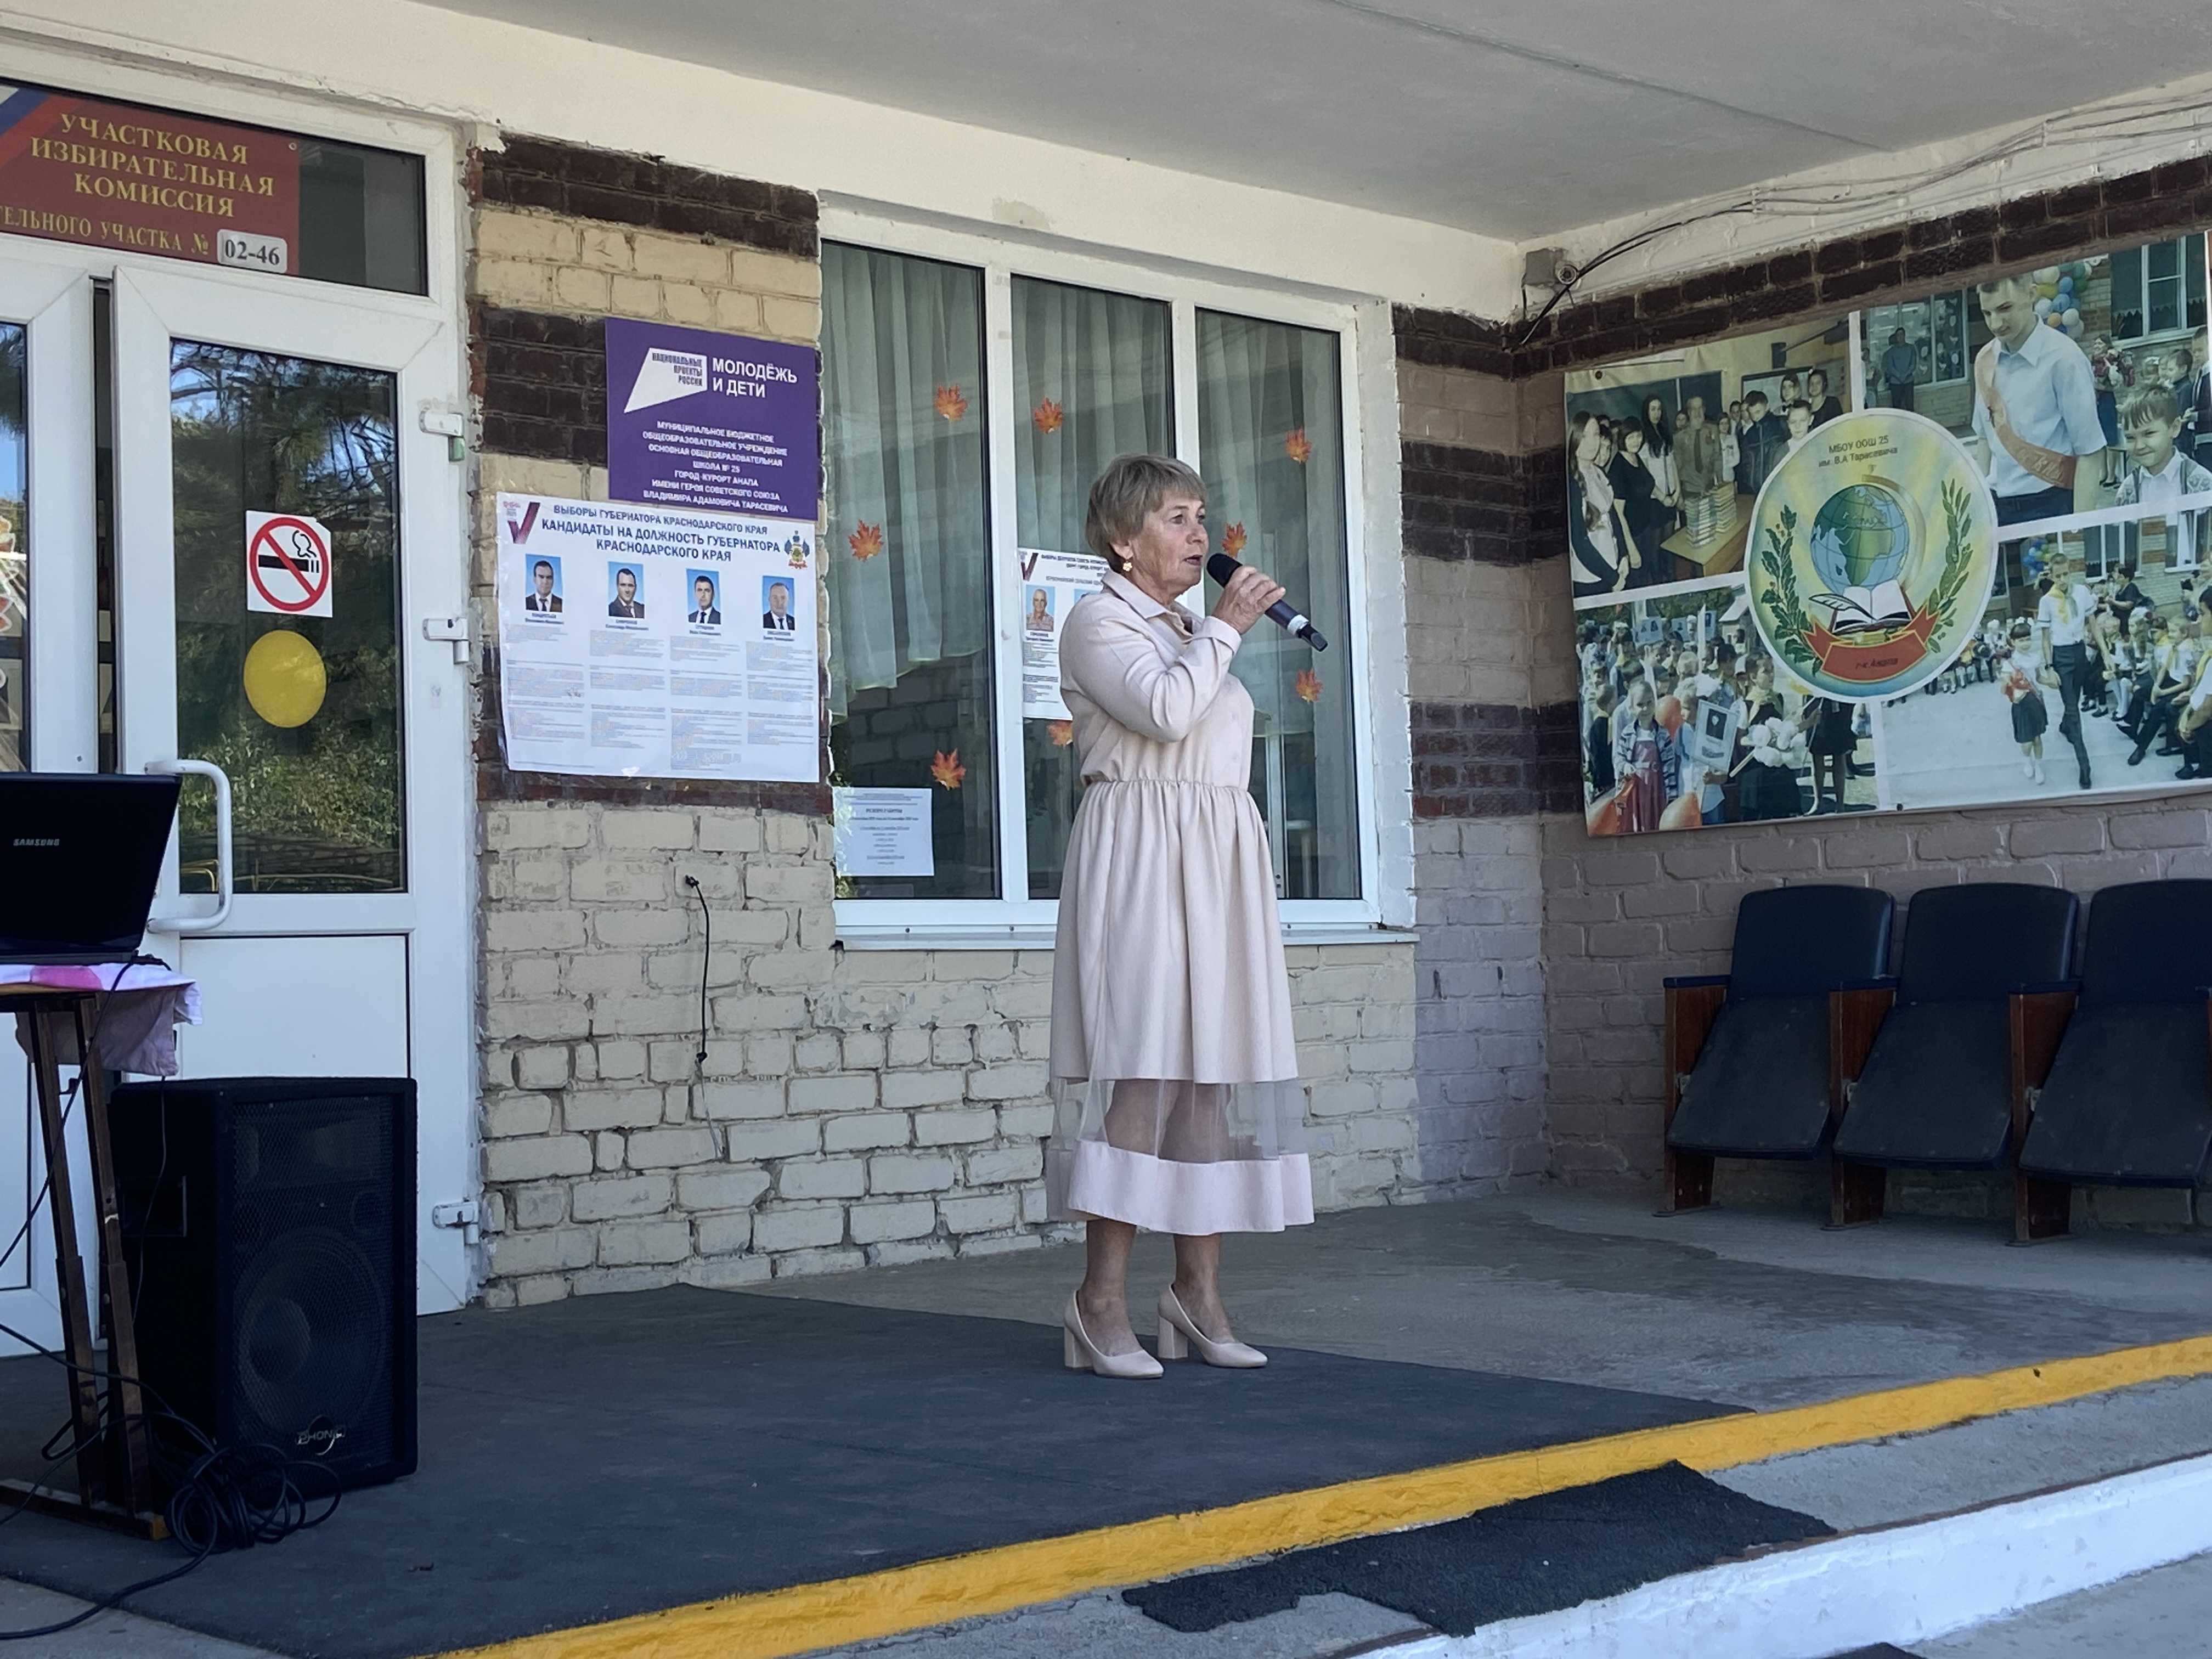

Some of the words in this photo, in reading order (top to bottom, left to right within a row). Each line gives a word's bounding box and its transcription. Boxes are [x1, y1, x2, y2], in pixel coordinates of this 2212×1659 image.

[60, 113, 247, 164] УЧАСТКОВАЯ
[31, 137, 273, 196] ИЗБИРАТЕЛЬНАЯ
[75, 173, 234, 217] КОМИССИЯ
[0, 205, 91, 238] ЕЛЬНОГО
[101, 222, 182, 251] УЧАСТКА
[191, 233, 208, 255] №
[225, 239, 280, 265] 02-46
[673, 364, 702, 377] ПРОЕКТЫ
[678, 375, 702, 386] РОССИИ
[713, 357, 798, 383] МОЛОДЁЖЬ
[713, 377, 723, 392] И
[726, 379, 766, 398] ДЕТИ
[642, 431, 736, 450] ОБЩЕОБРАЗОВАТЕЛЬНОЕ
[737, 443, 787, 456] УЧРЕЖДЕНИЕ
[657, 421, 725, 437] МУНИЦИПАЛЬНОЕ
[726, 430, 774, 443] БЮДЖЕТНОЕ
[648, 443, 690, 455] ОСНОВНАЯ
[690, 449, 783, 467] ОБЩЕОБРАЗОВАТЕЛЬНАЯ
[1829, 441, 1853, 453] МБОУ
[1855, 437, 1876, 449] ООШ
[1878, 435, 1889, 444] 25
[1849, 447, 1898, 462] Тарасевича
[693, 460, 720, 471] ШКОЛА
[731, 465, 740, 473] 25
[652, 479, 679, 489] ИМЕНИ
[681, 482, 703, 492] ГЕРОЯ
[705, 486, 752, 498] СОВЕТСКОГО
[753, 491, 780, 500] СОЮЗА
[732, 477, 759, 487] АНАПА
[644, 490, 691, 503] ВЛАДИМИРА
[693, 495, 741, 508] АДАМОВИЧА
[742, 500, 788, 513] ТАРАСЕВИЧА
[554, 505, 597, 517] ВЫБОРЫ
[600, 509, 661, 524] ГУБЕРНАТОРА
[664, 516, 743, 533] КРАСНОДАРСКОГО
[745, 525, 767, 535] КРАЯ
[542, 519, 613, 536] КАНДИДАТЫ
[617, 527, 633, 538] НА
[635, 528, 704, 545] ДОЛЖНОСТЬ
[707, 535, 780, 553] ГУБЕРНАТОРА
[596, 539, 698, 559] КРАСНОДАРСКОГО
[702, 550, 732, 562] КРАЯ
